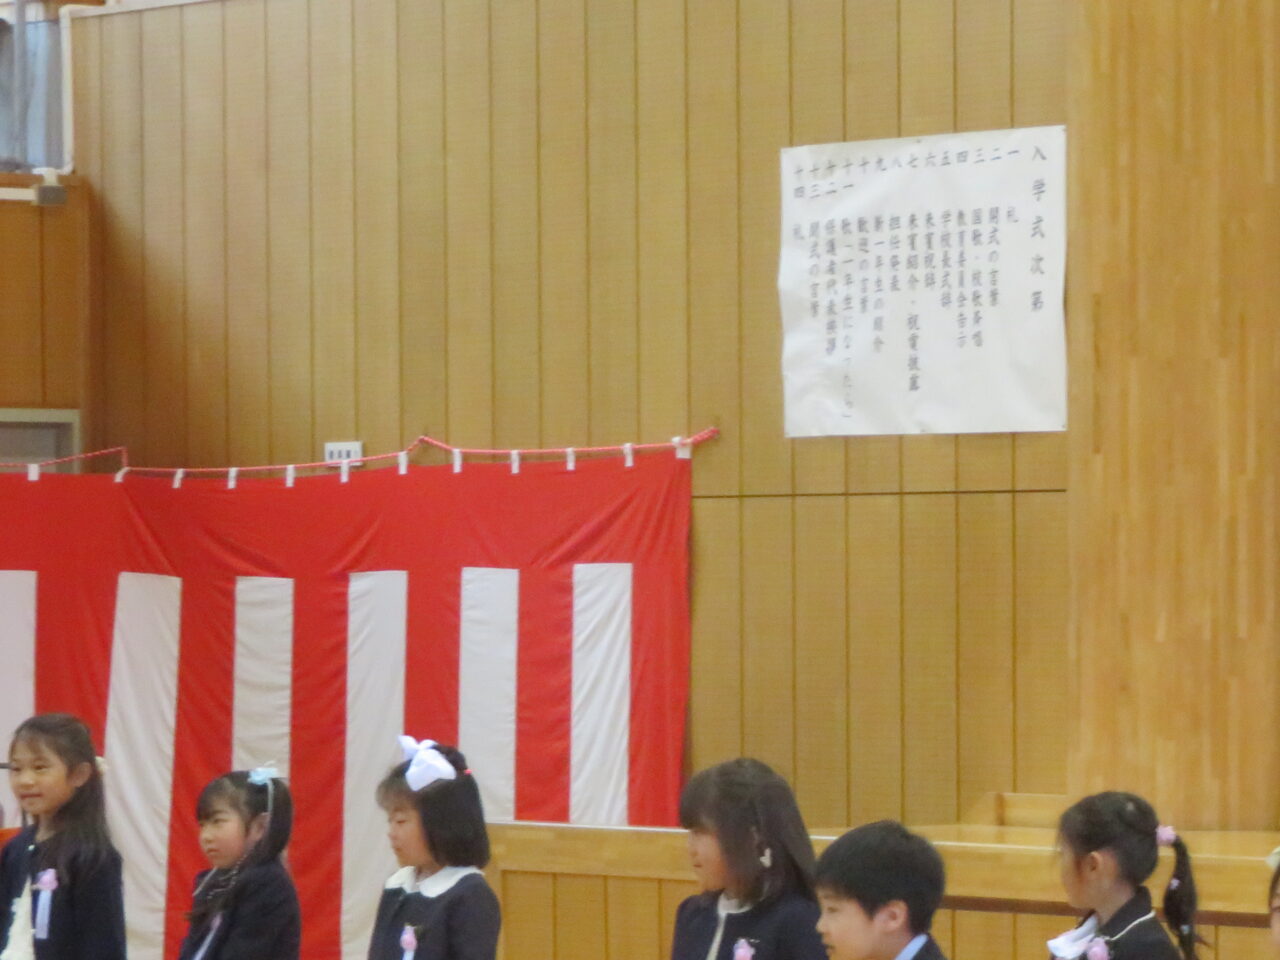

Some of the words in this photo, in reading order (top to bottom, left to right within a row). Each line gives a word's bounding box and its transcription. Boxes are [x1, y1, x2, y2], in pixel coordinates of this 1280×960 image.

[1030, 146, 1047, 311] 入学式次第
